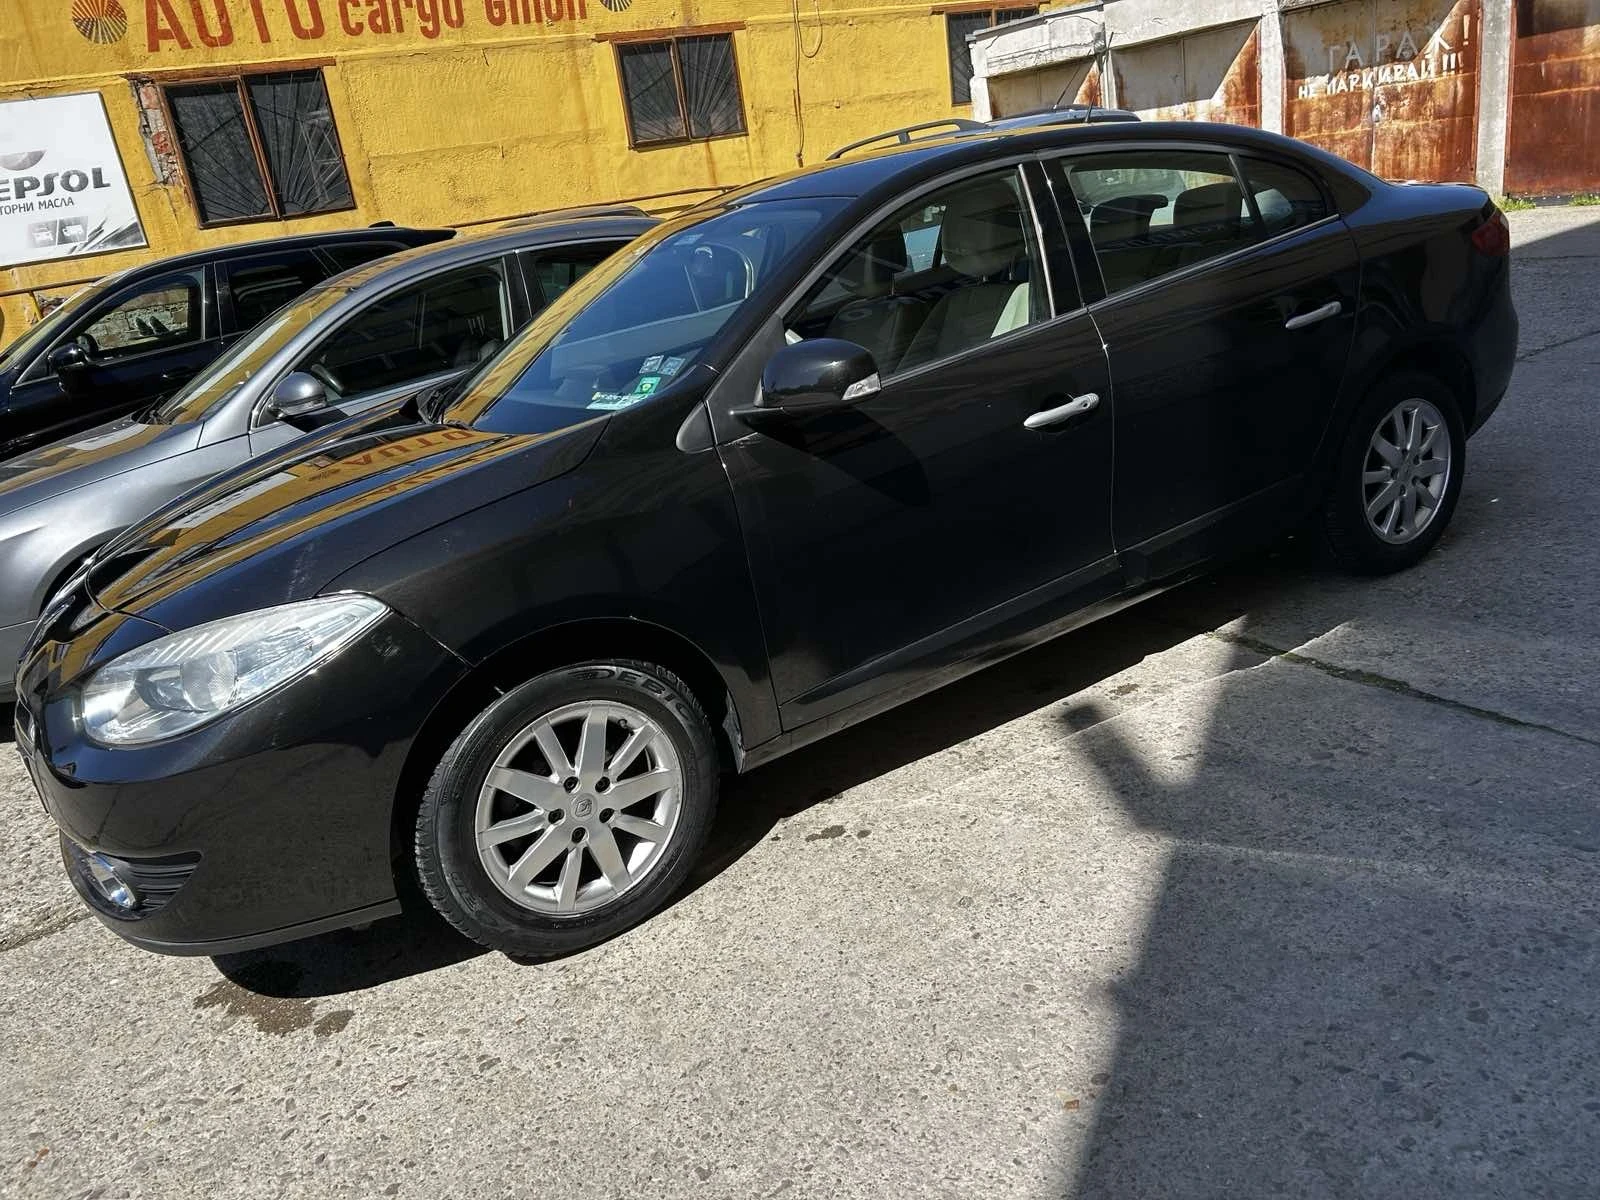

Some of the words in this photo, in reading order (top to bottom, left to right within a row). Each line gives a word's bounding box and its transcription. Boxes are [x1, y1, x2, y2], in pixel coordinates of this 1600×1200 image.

[145, 0, 325, 52] AUTO
[339, 0, 465, 39] cargo
[1299, 83, 1319, 99] НЕ
[38, 196, 75, 210] МАСЛА
[567, 668, 707, 735] DEBIC
